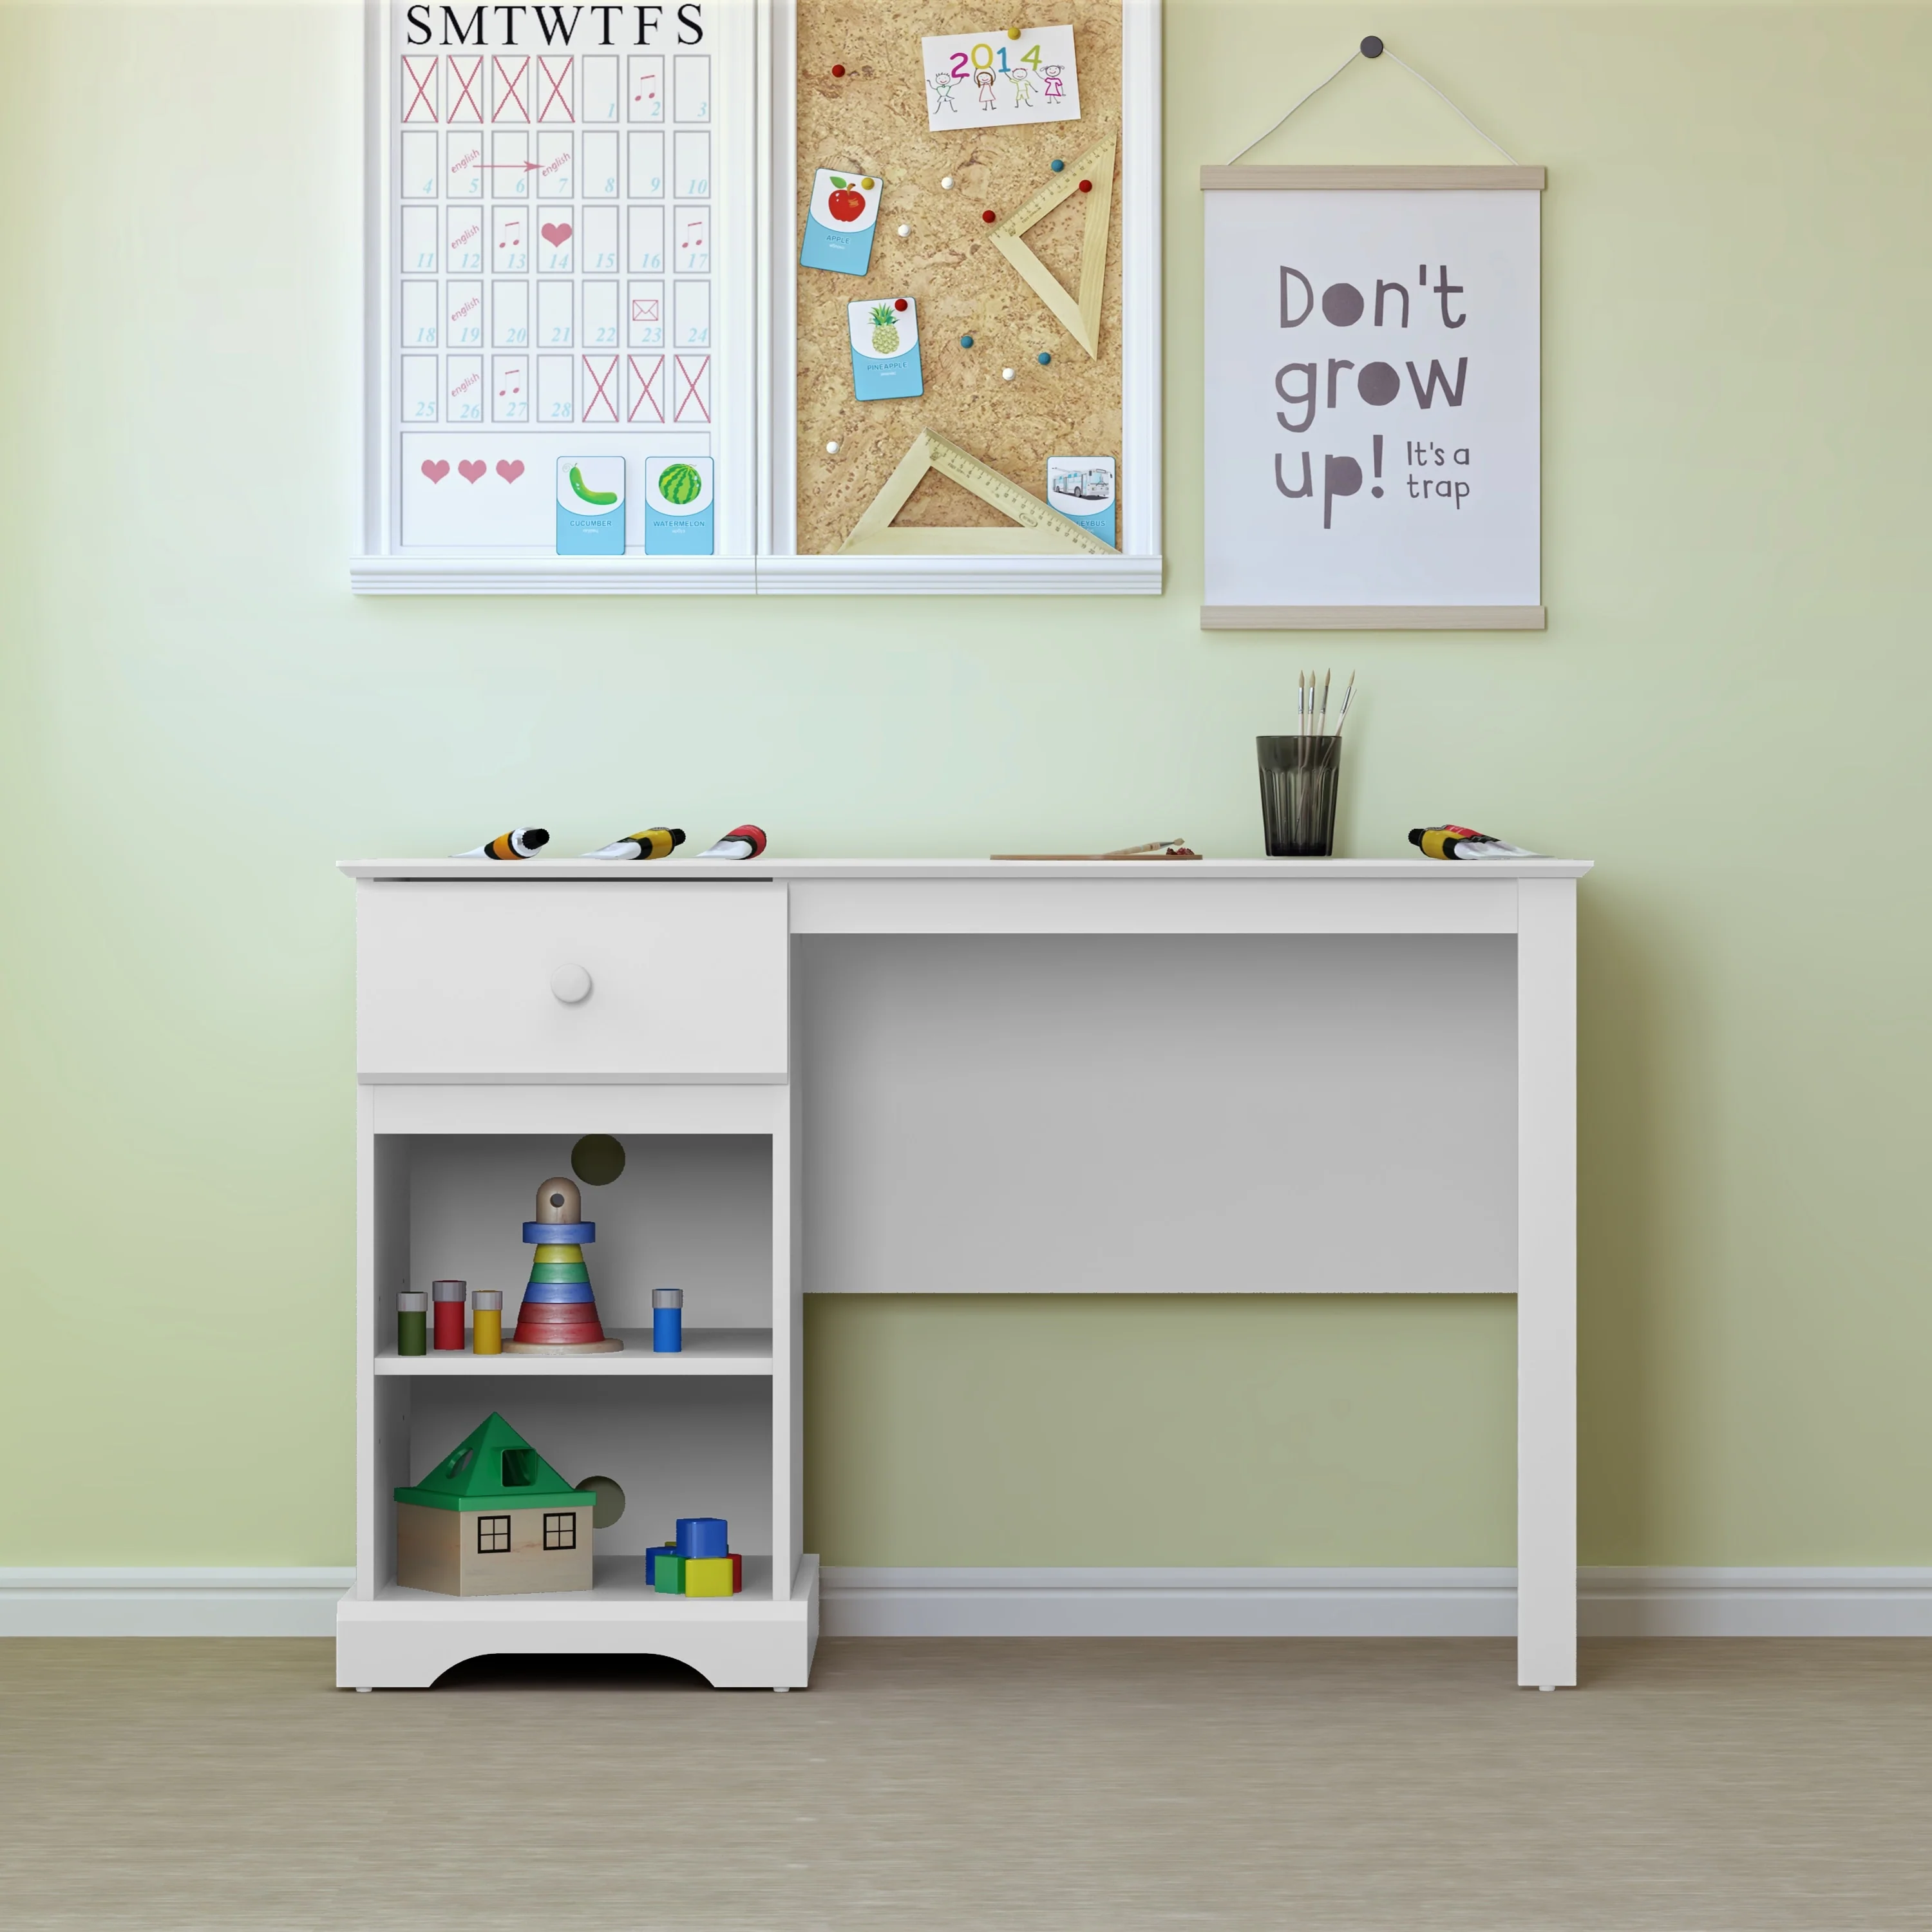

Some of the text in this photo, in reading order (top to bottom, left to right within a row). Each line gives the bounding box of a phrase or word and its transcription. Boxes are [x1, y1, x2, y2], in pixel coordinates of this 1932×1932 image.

[950, 43, 1042, 78] 2014
[608, 101, 707, 118] 1 2 3
[451, 149, 480, 173] english
[542, 153, 571, 176] english
[422, 176, 708, 194] 4 5 6 7 8 9 10
[451, 225, 480, 249] english
[826, 235, 850, 244] APPLE
[416, 253, 708, 269] 11 12 13 14 15 16 17
[1280, 264, 1466, 328] Don't
[451, 298, 480, 321] english
[416, 327, 708, 343] 18 19 20 21 22 23 24
[867, 361, 907, 371] PINEAPPLE
[451, 374, 480, 397] english
[1275, 357, 1468, 433] grow
[415, 401, 571, 419] 25 26 27 28
[1406, 440, 1470, 466] It's a
[1274, 434, 1385, 529] up!
[1406, 473, 1470, 510] trap
